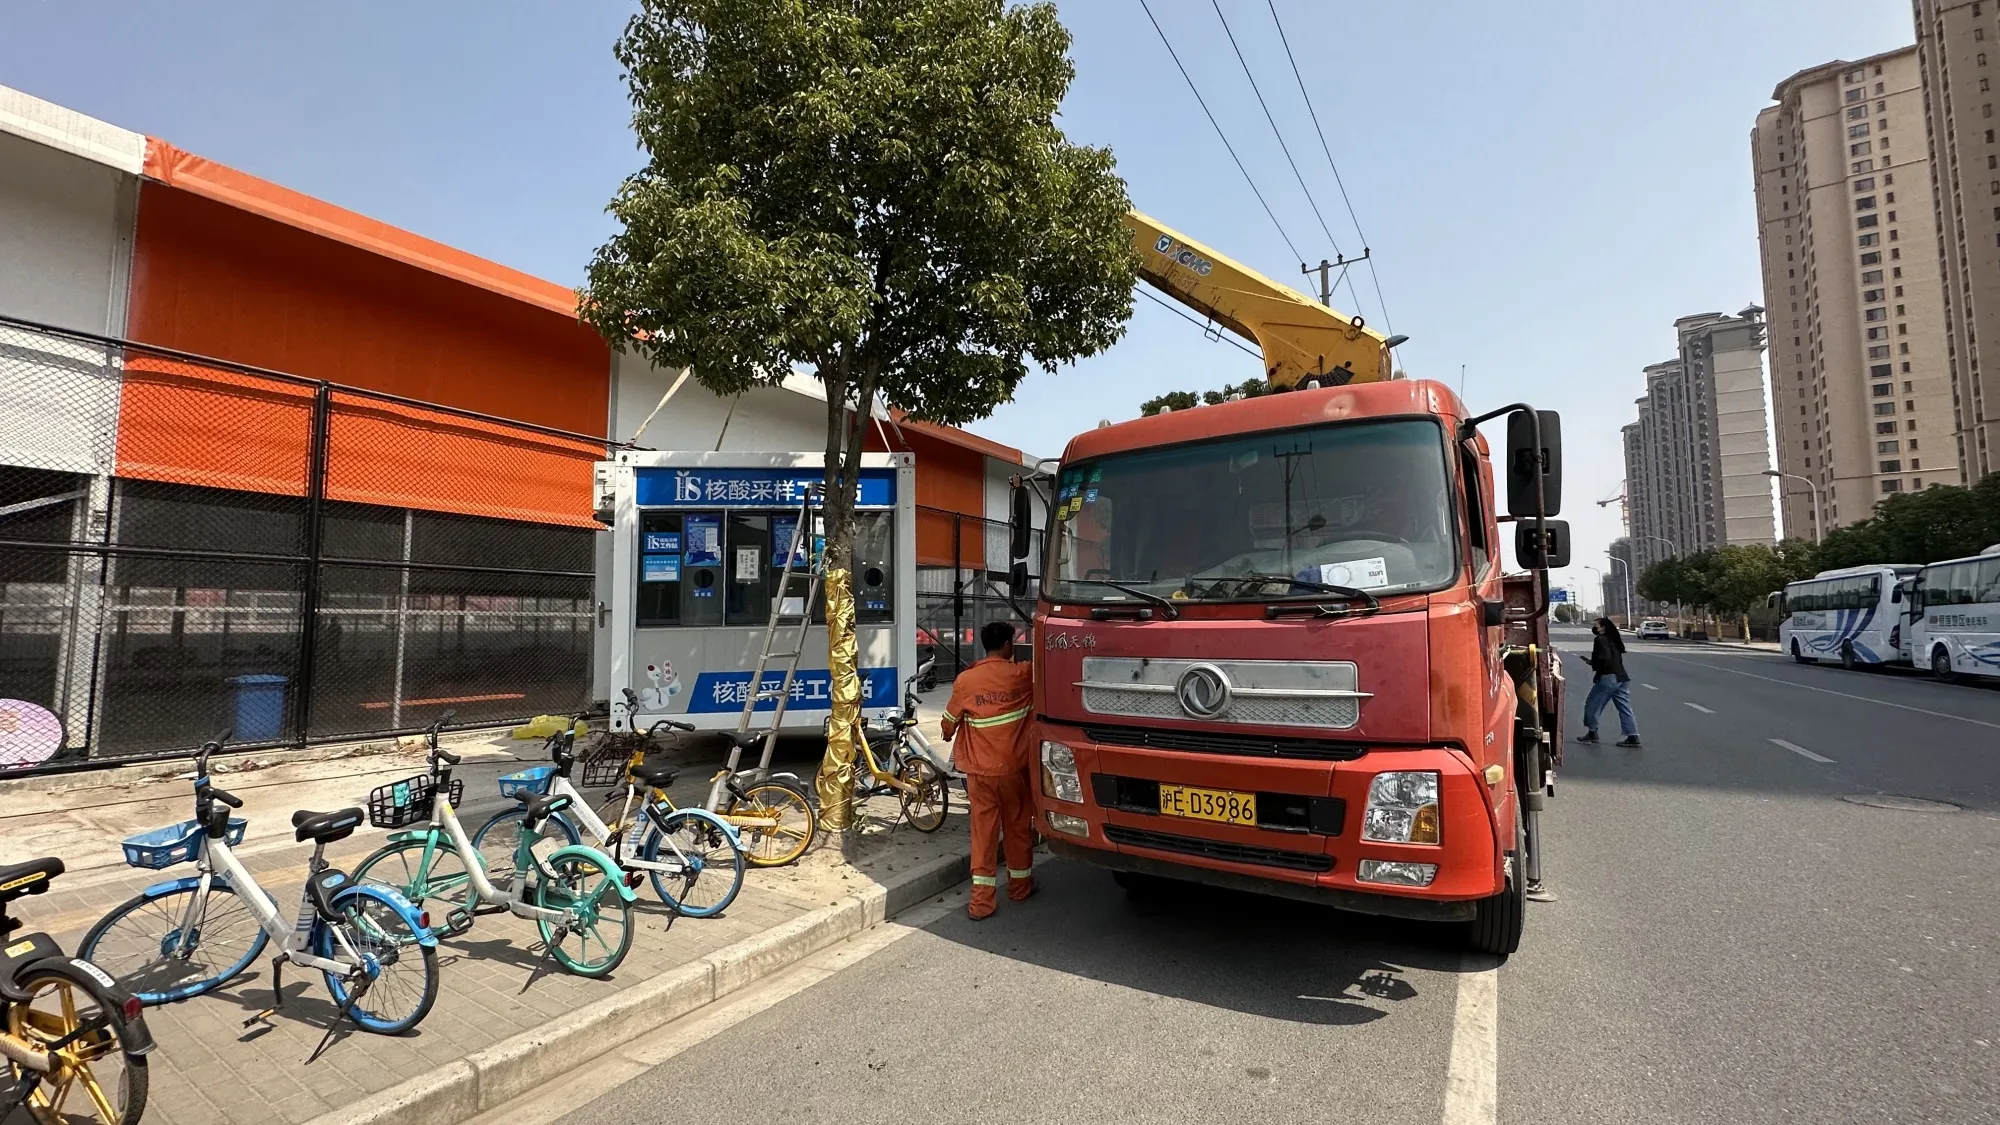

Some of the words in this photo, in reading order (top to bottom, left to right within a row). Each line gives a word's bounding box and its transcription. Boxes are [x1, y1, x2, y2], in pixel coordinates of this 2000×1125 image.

[1169, 244, 1213, 276] XCMG
[705, 479, 862, 502] 核酸采样工
[712, 679, 873, 704] 核酸采样工
